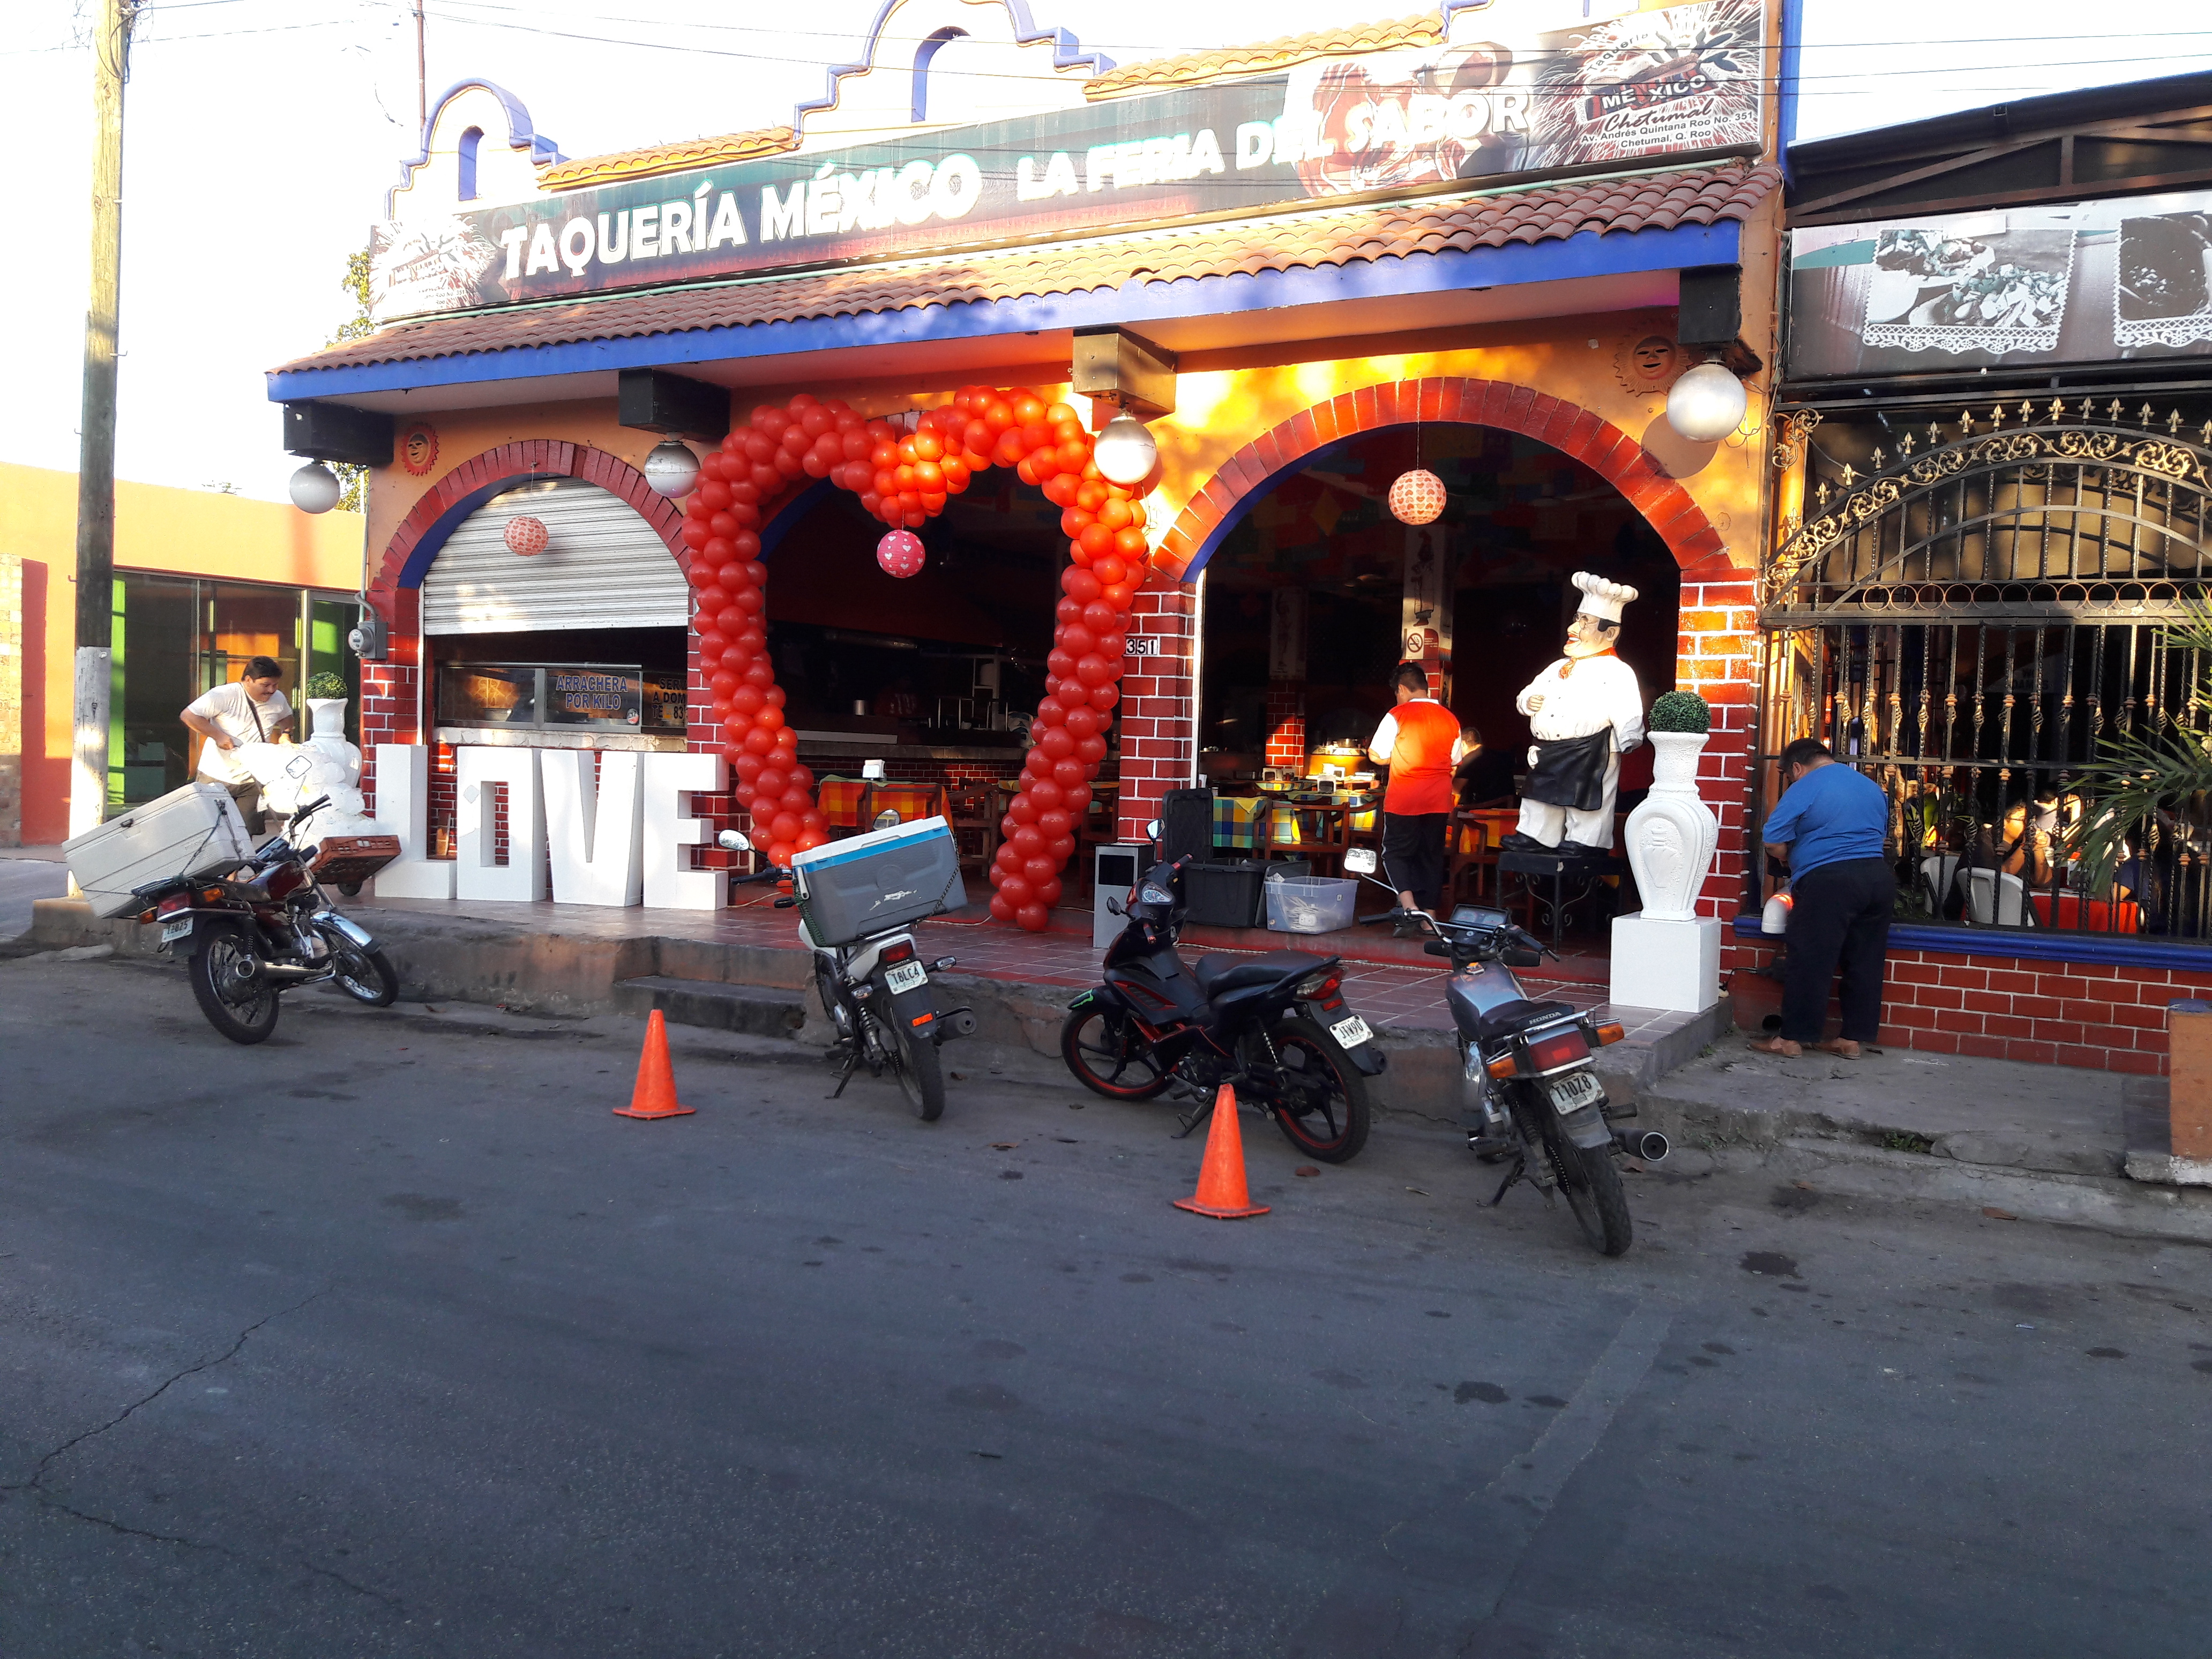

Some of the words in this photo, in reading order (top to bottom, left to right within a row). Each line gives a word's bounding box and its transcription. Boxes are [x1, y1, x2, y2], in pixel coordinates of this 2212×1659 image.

[1604, 98, 1715, 132] Chetumal
[1581, 134, 1597, 143] Av.
[1601, 128, 1636, 140] Andrés
[1640, 122, 1686, 136] Quintana
[1690, 118, 1710, 128] Roo
[1714, 115, 1731, 124] No.
[1735, 111, 1753, 121] 351
[1621, 134, 1672, 147] Chetumal,
[1675, 132, 1686, 140] Q.
[1690, 129, 1711, 138] Roo
[500, 179, 748, 280] TAQUERÍA
[760, 153, 982, 243] MÉXICO
[1017, 151, 1079, 201] LA
[1086, 128, 1225, 192] FERIA
[1236, 114, 1335, 170] DEL
[1344, 86, 1530, 153] SABOR
[1126, 639, 1154, 654] 351
[556, 675, 628, 692] ARRACHERA
[565, 693, 589, 709] POR
[592, 693, 622, 711] KILO
[652, 691, 660, 703] A
[375, 743, 729, 911] LOVE
[1528, 1011, 1563, 1025] HONDA
